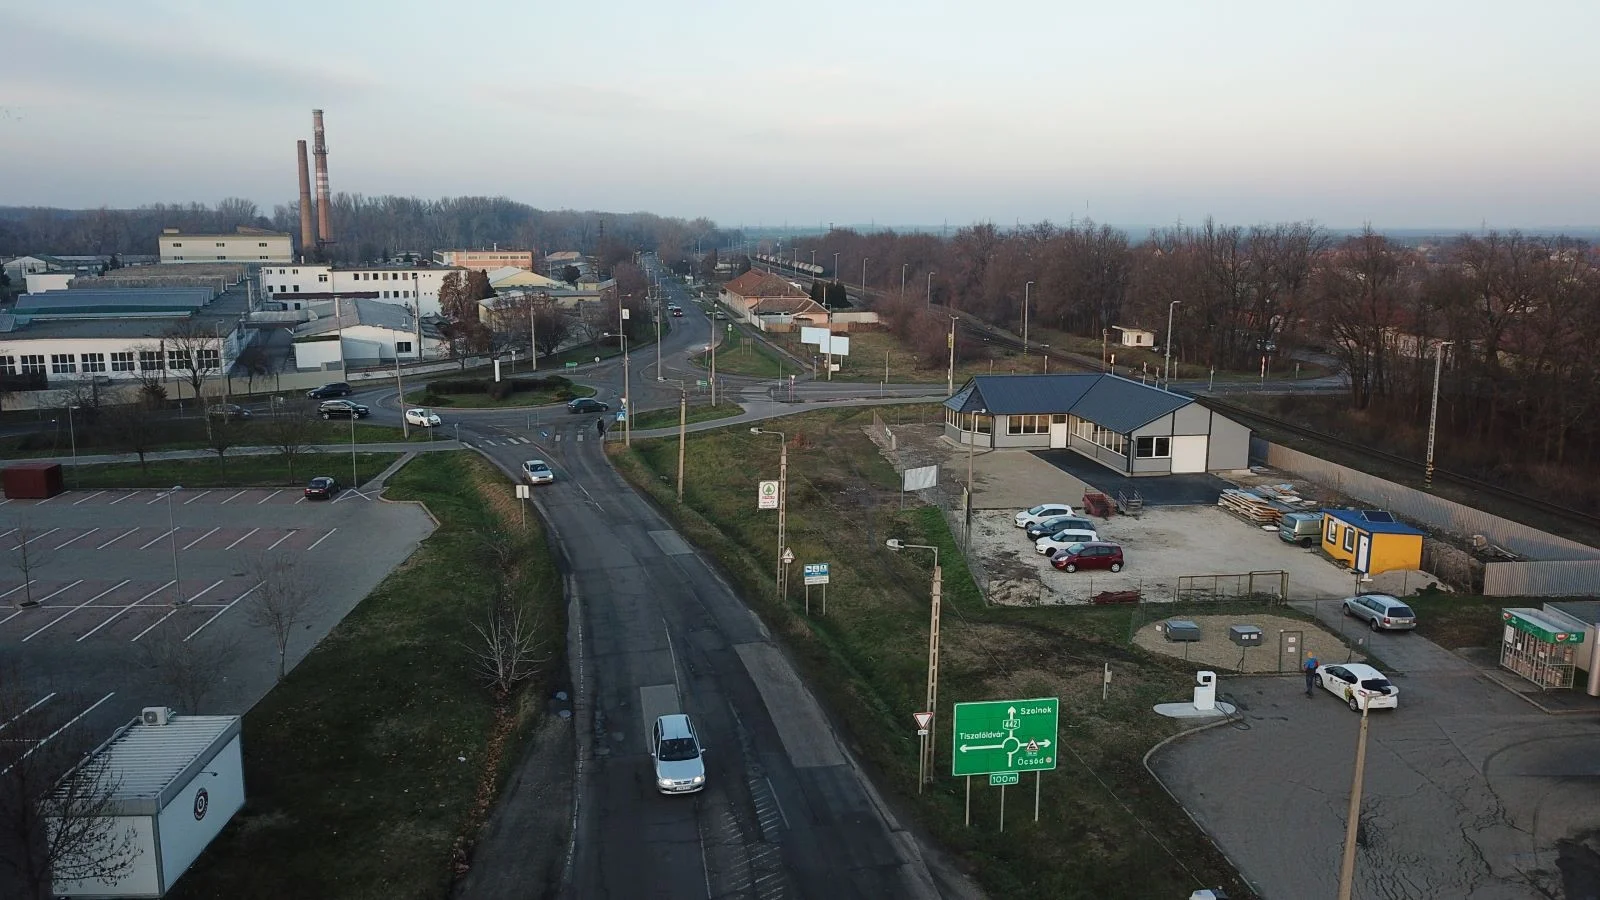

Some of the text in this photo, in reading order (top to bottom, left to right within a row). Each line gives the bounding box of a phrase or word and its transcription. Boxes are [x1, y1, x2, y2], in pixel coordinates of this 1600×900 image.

[1020, 706, 1052, 715] Szolnok
[1004, 720, 1018, 728] 442
[959, 730, 1005, 740] Tiszaföldvár
